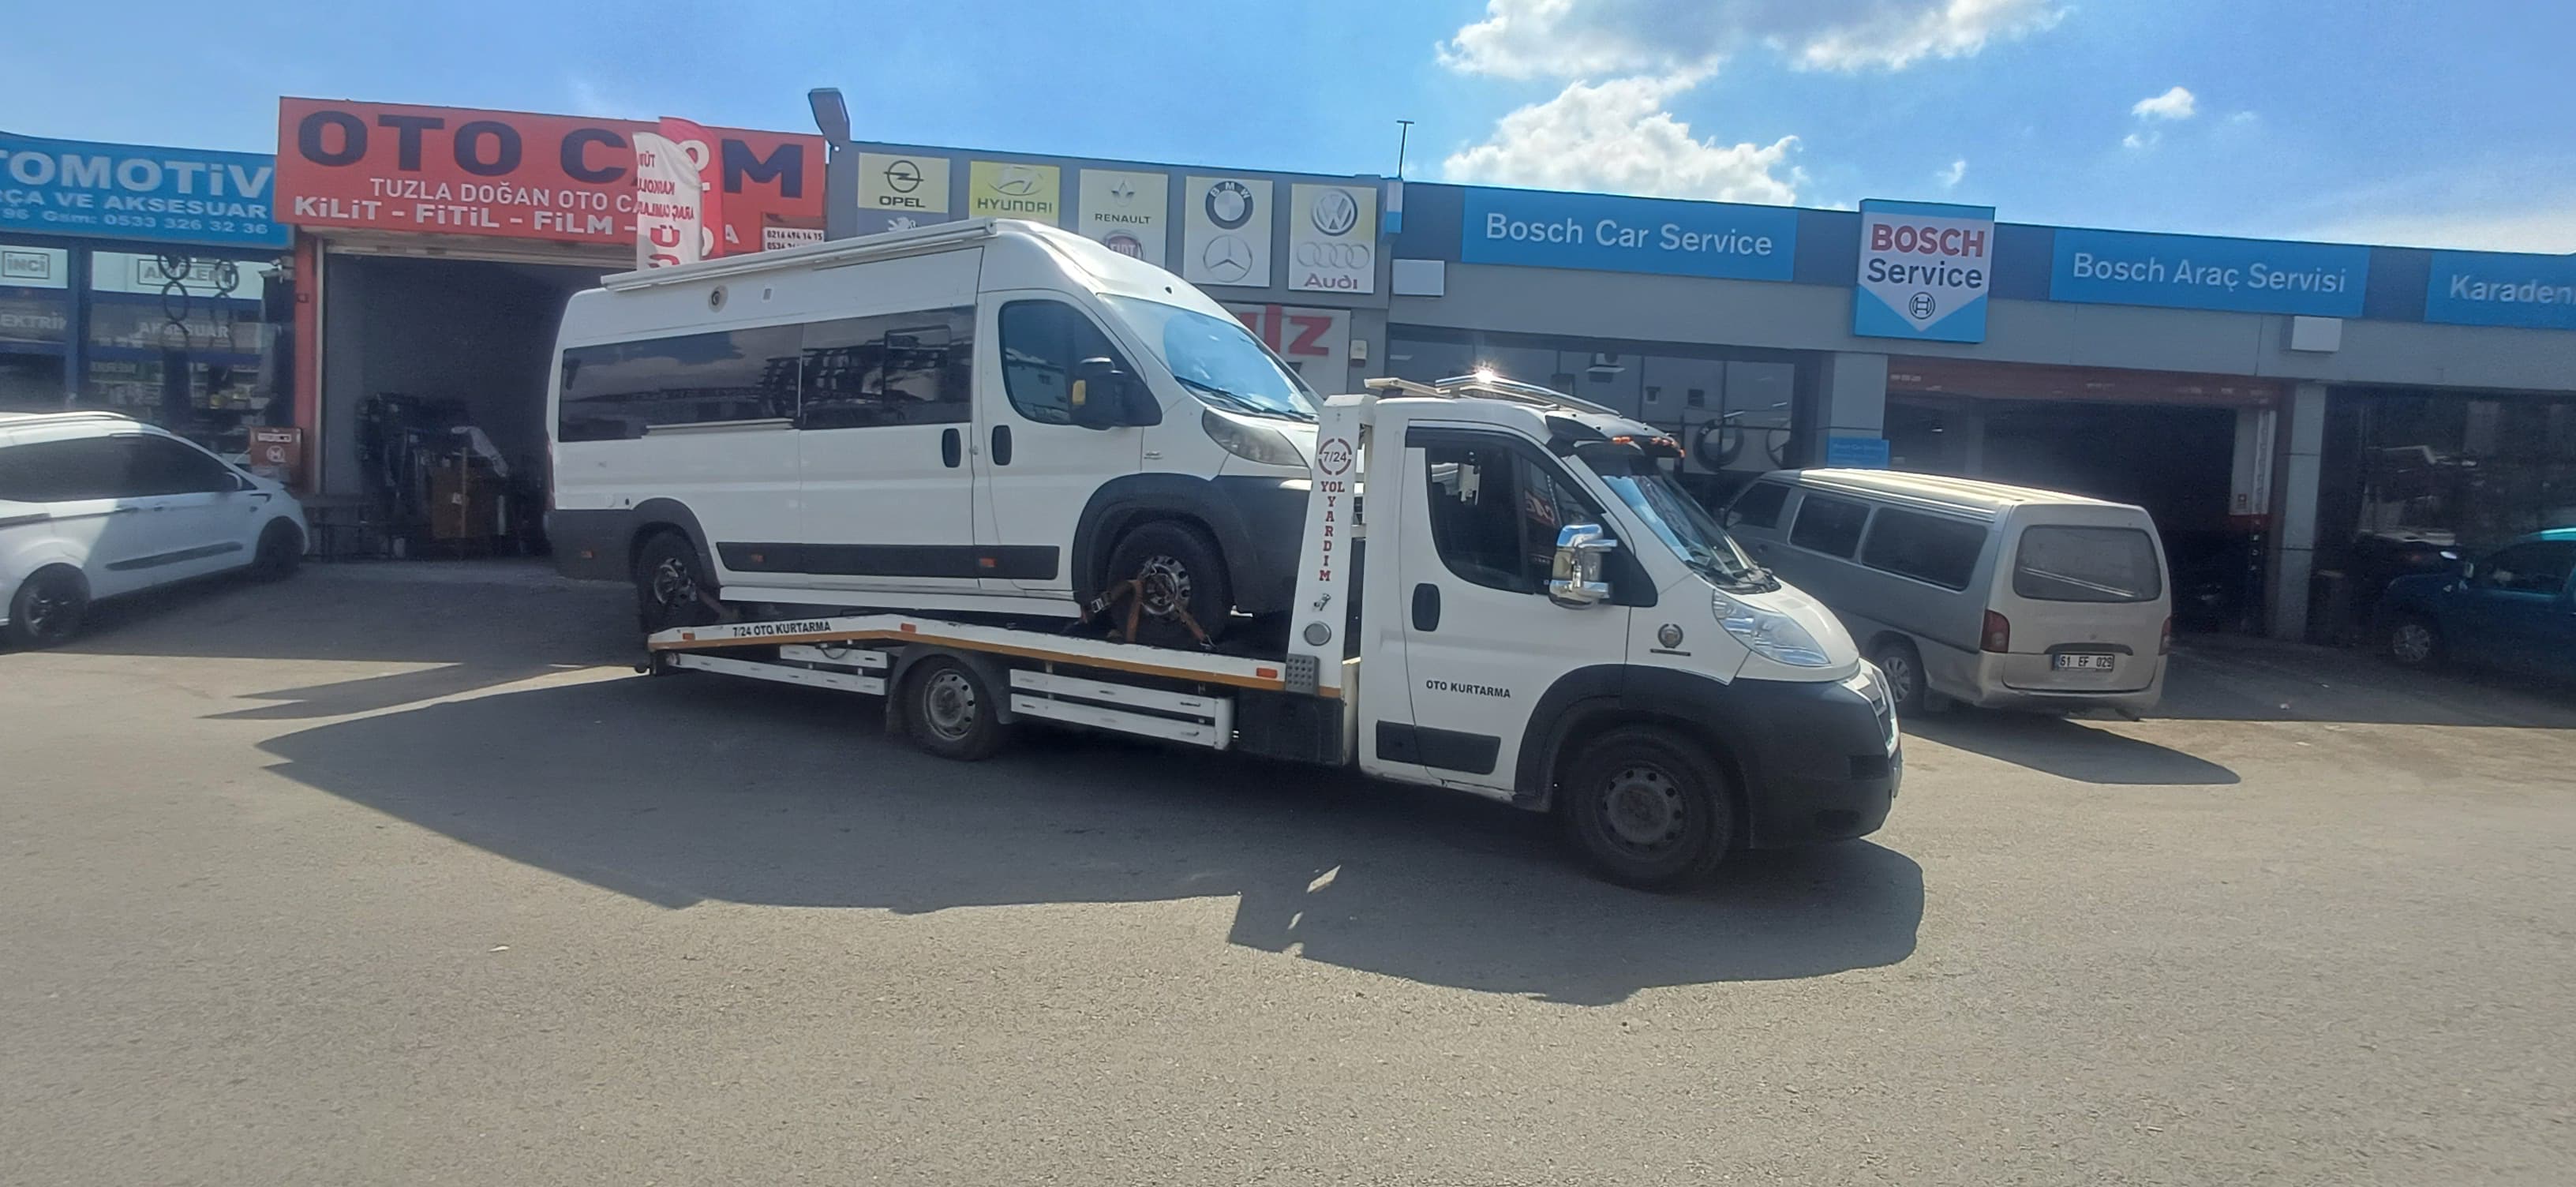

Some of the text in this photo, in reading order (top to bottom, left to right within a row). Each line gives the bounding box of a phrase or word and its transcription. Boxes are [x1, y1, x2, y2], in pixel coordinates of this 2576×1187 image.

[298, 110, 522, 177] OTO
[560, 128, 803, 199] CM
[0, 150, 272, 199] OMOTiV
[0, 189, 268, 219] ÇA VE AKSESUAR
[369, 178, 452, 200] TUZLA
[461, 182, 550, 207] DOĞAN
[559, 190, 608, 211] OTO
[879, 196, 926, 208] OPEL
[977, 198, 1052, 214] HYUNDAI
[103, 214, 156, 228] 0533
[164, 217, 202, 230] 326
[209, 220, 236, 233] 32
[243, 223, 268, 234] 36
[1095, 213, 1151, 224] RENAULT
[1485, 212, 1773, 256] Bosch Car Service
[1871, 223, 1985, 257] BOSCH
[1304, 272, 1358, 290] Audi
[1866, 258, 1983, 289] Service
[2072, 252, 2347, 294] Bosch Araç Servisi
[1324, 451, 1347, 462] 7/24
[1320, 481, 1345, 492] YOL
[754, 624, 774, 635] OTO
[775, 621, 831, 635] KURTARMA
[1425, 680, 1511, 698] OTO KURTARMA
